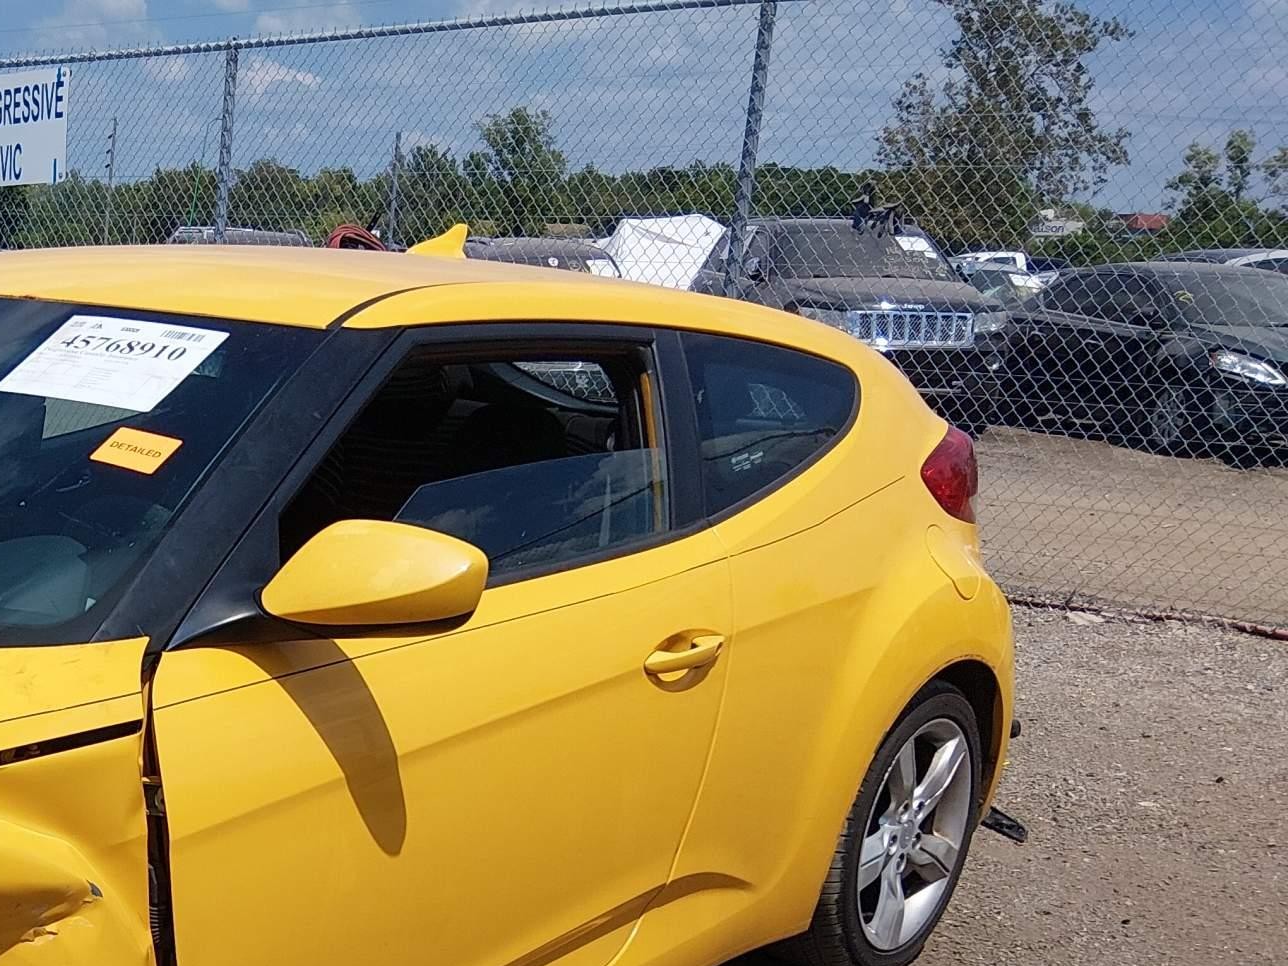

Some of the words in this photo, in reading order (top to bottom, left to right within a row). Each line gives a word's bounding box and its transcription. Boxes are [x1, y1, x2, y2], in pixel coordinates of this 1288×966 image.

[0, 143, 23, 181] VIC
[60, 334, 187, 361] 45768910
[109, 440, 162, 458] DETAILED
